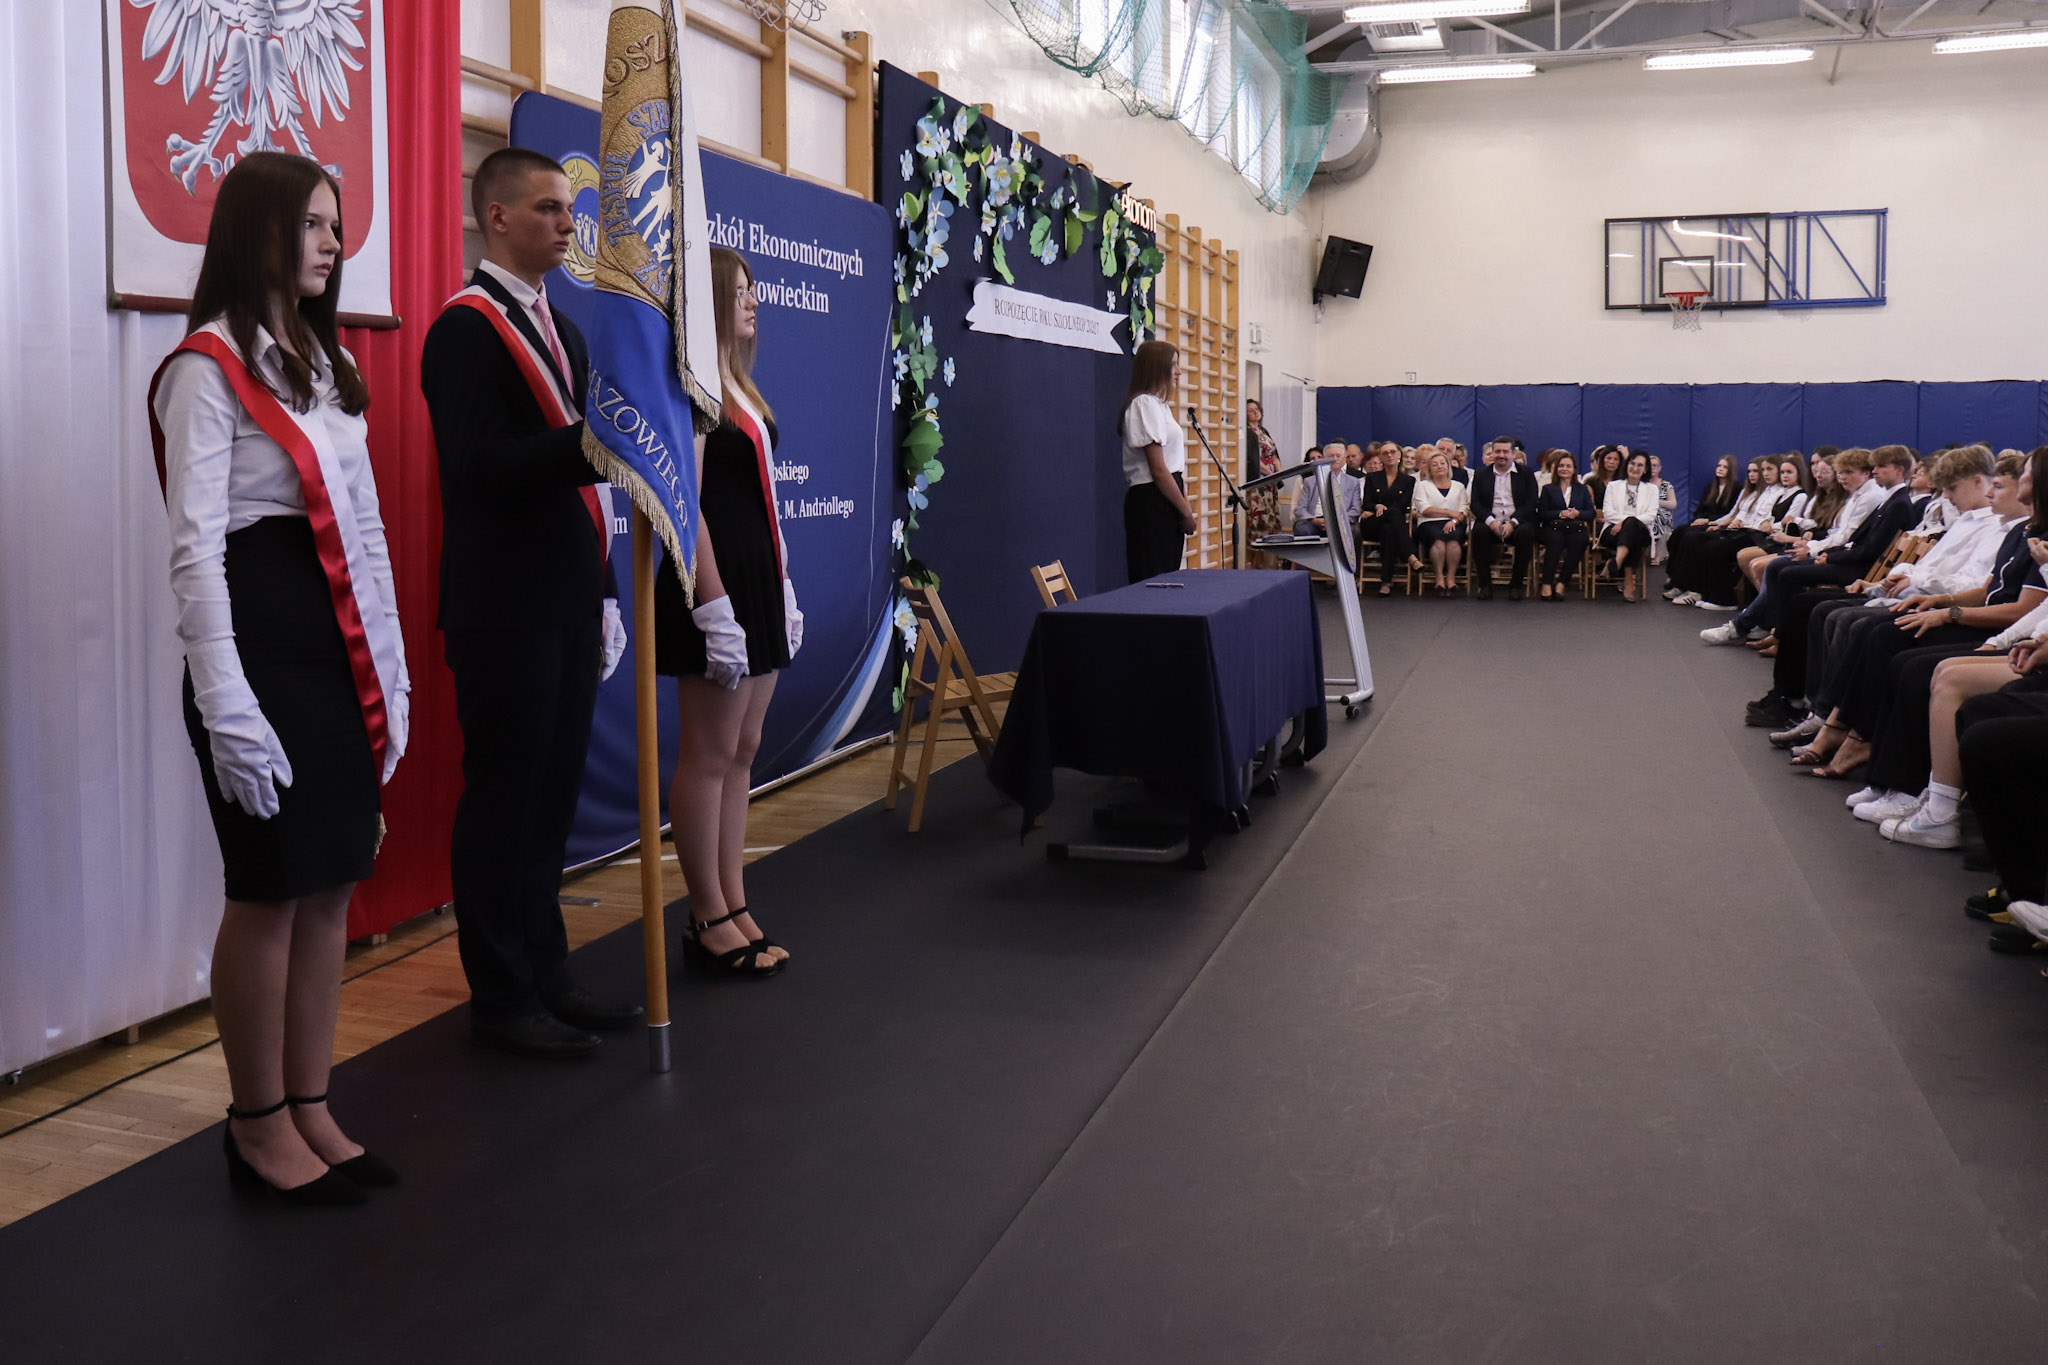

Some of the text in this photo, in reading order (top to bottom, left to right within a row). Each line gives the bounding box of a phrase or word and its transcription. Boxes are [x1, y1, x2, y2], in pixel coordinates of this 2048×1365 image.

[706, 213, 864, 281] zkół Ekonomicznych
[785, 500, 797, 519] M.
[799, 496, 854, 519] Andriollego
